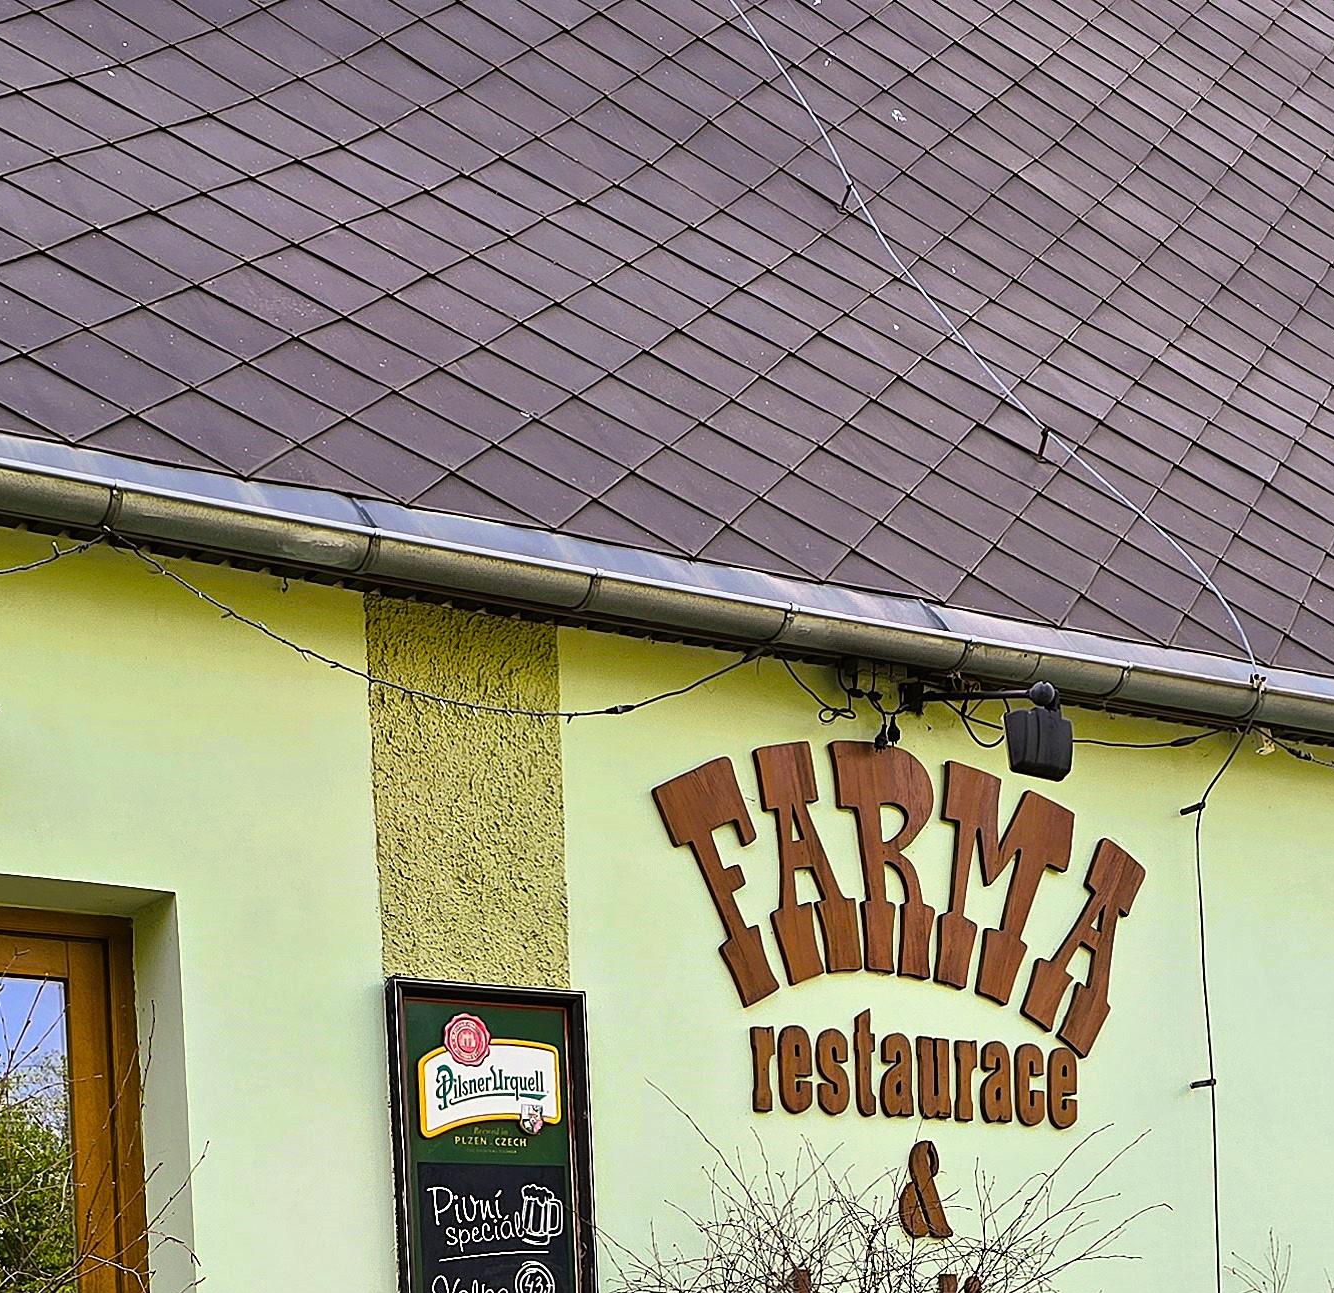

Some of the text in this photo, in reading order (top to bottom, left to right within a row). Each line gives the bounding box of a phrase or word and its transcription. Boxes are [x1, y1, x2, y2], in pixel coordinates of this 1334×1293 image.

[652, 740, 1145, 1058] FARMA
[435, 1064, 545, 1110] Pilsner Urquell
[750, 1008, 1078, 1130] restaurace
[495, 1137, 527, 1147] CZECH
[427, 1186, 503, 1226] Pivní
[899, 1140, 954, 1238] &
[445, 1211, 525, 1252] speciál
